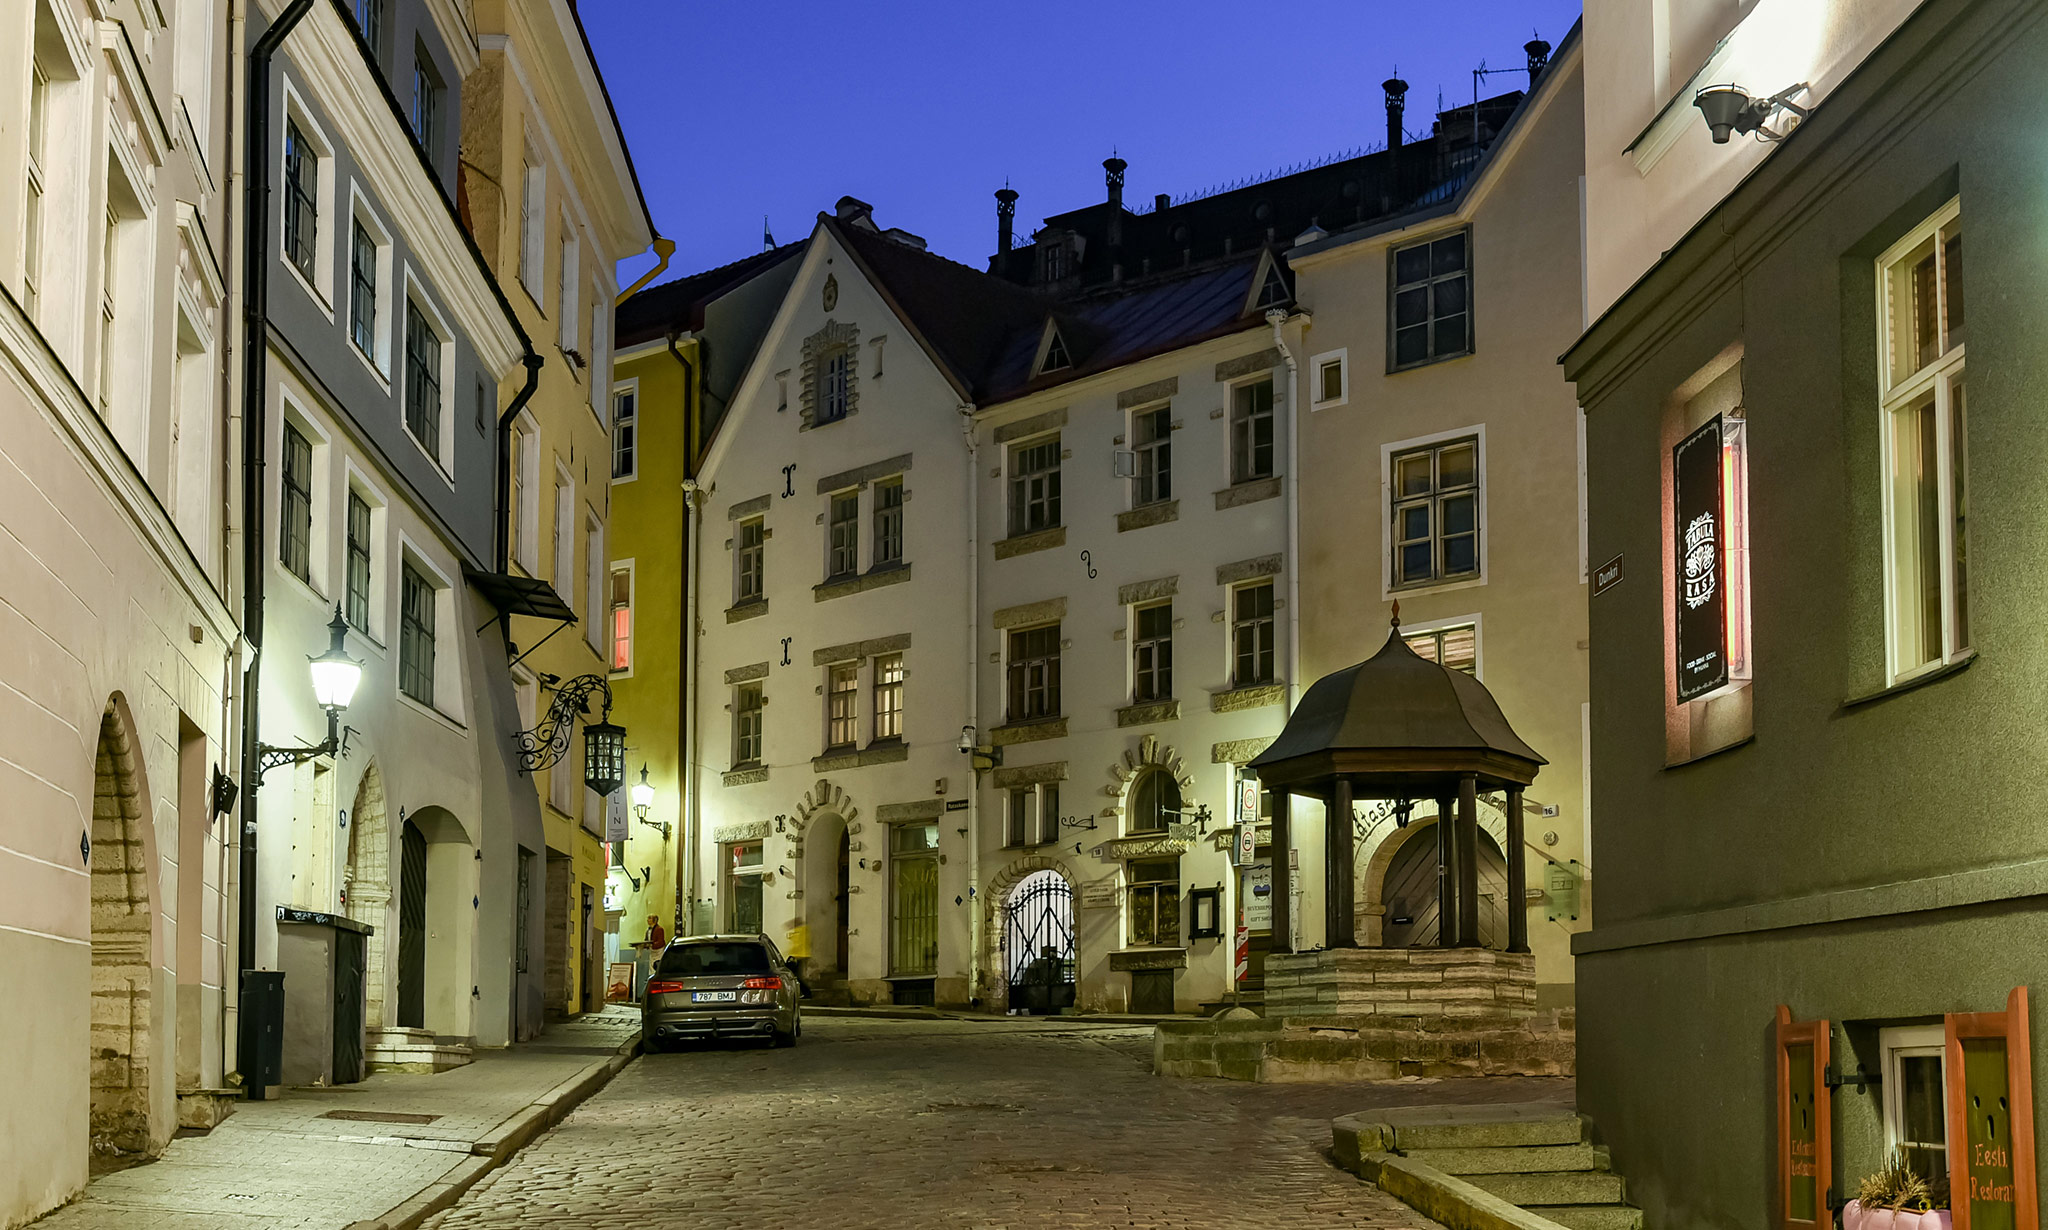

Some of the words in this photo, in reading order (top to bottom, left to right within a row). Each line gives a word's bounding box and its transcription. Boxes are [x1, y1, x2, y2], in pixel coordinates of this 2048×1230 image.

[1686, 523, 1713, 550] TABULA
[1599, 563, 1617, 586] Dunkri
[1687, 571, 1715, 597] RASA
[1975, 1144, 2007, 1168] Eesti
